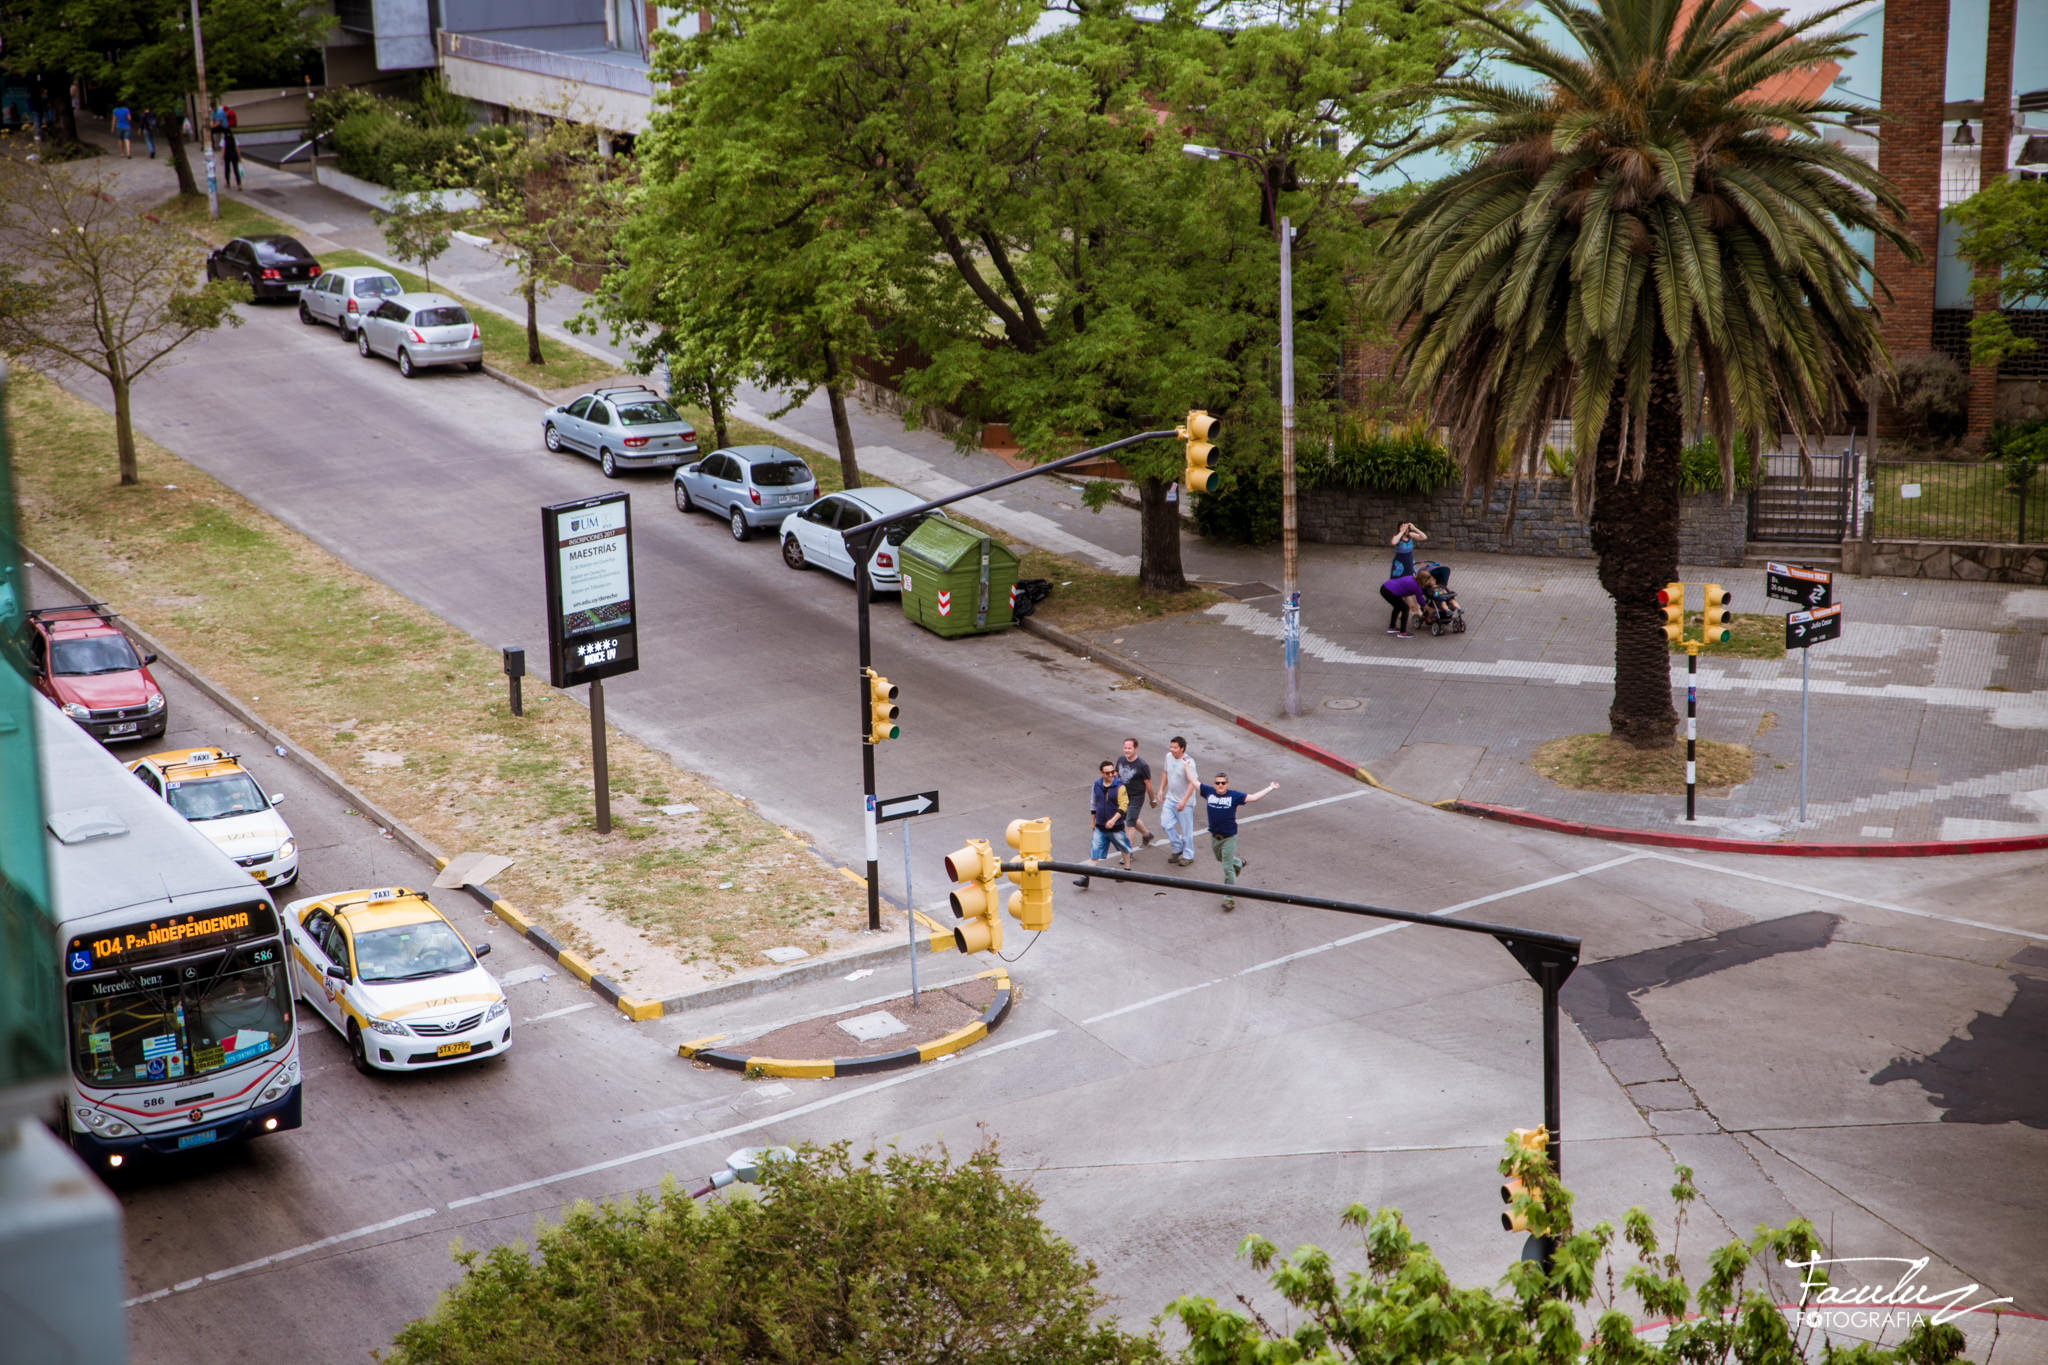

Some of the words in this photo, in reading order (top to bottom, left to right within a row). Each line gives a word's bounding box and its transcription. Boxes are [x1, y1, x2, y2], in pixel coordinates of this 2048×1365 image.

[581, 517, 599, 530] UM
[569, 543, 617, 561] MAESTRÍAS
[192, 753, 210, 762] TAXI
[373, 889, 391, 899] TAXI
[93, 938, 123, 959] 104
[253, 950, 273, 963] 586
[143, 1098, 164, 1108] 586
